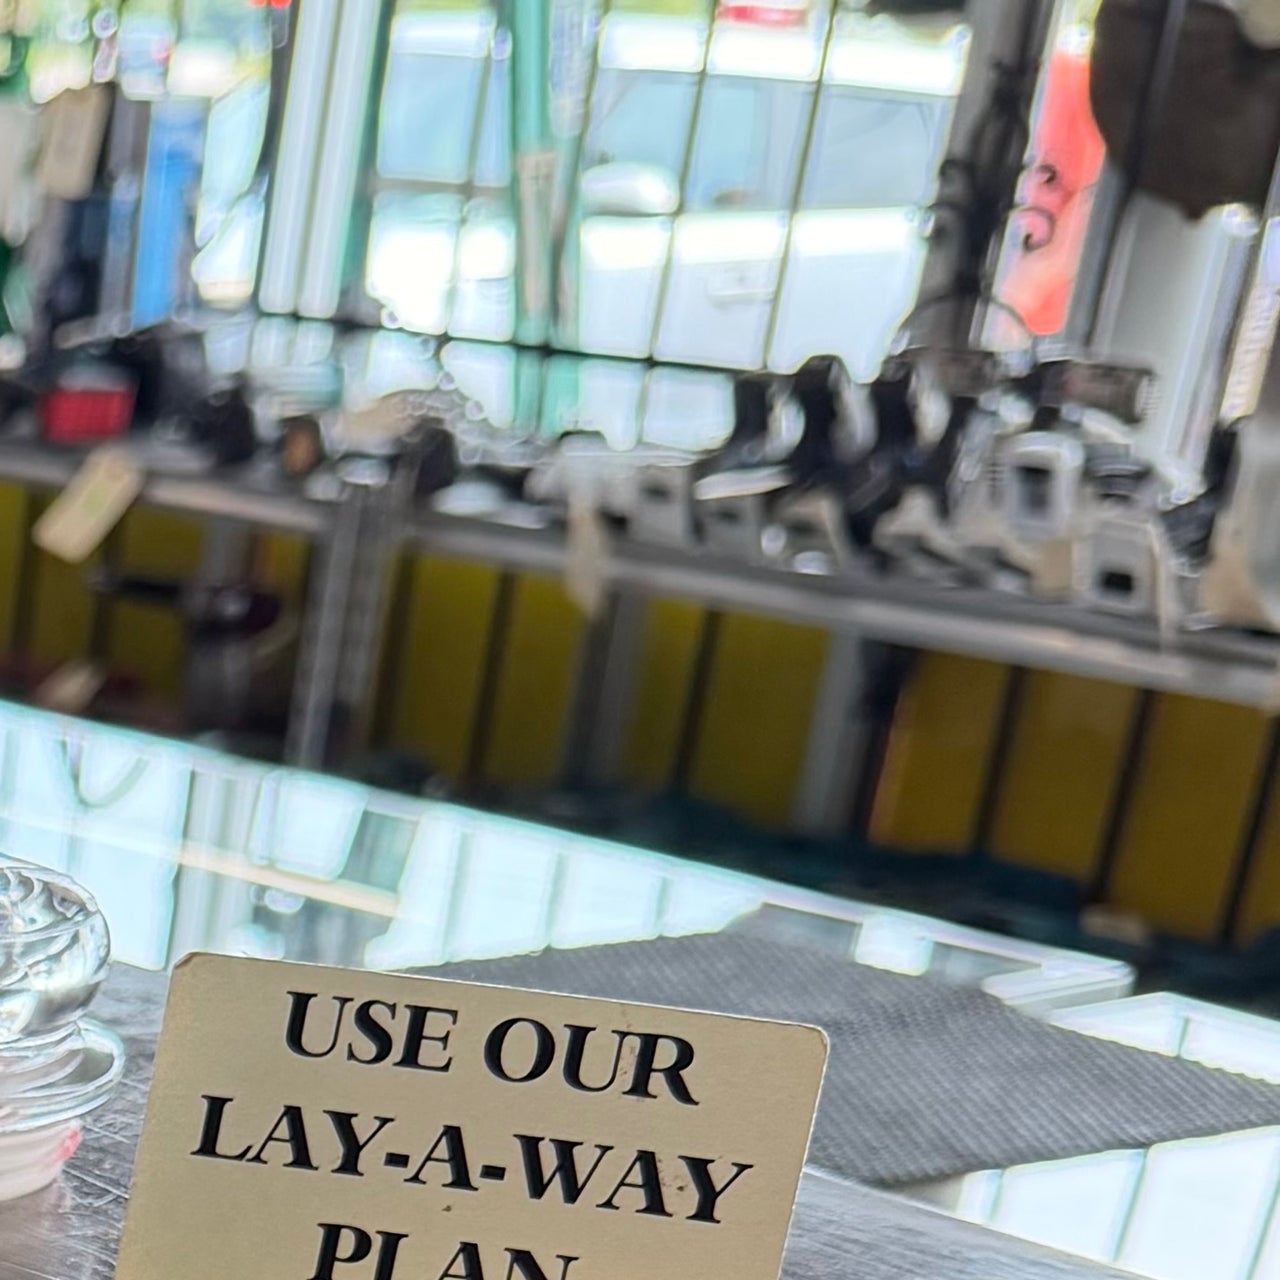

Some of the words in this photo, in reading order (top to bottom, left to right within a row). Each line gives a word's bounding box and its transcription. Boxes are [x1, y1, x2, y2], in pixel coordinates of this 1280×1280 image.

[285, 990, 459, 1073] USE
[482, 1016, 701, 1107] OUR
[190, 1093, 754, 1224] LAY-A-WAY
